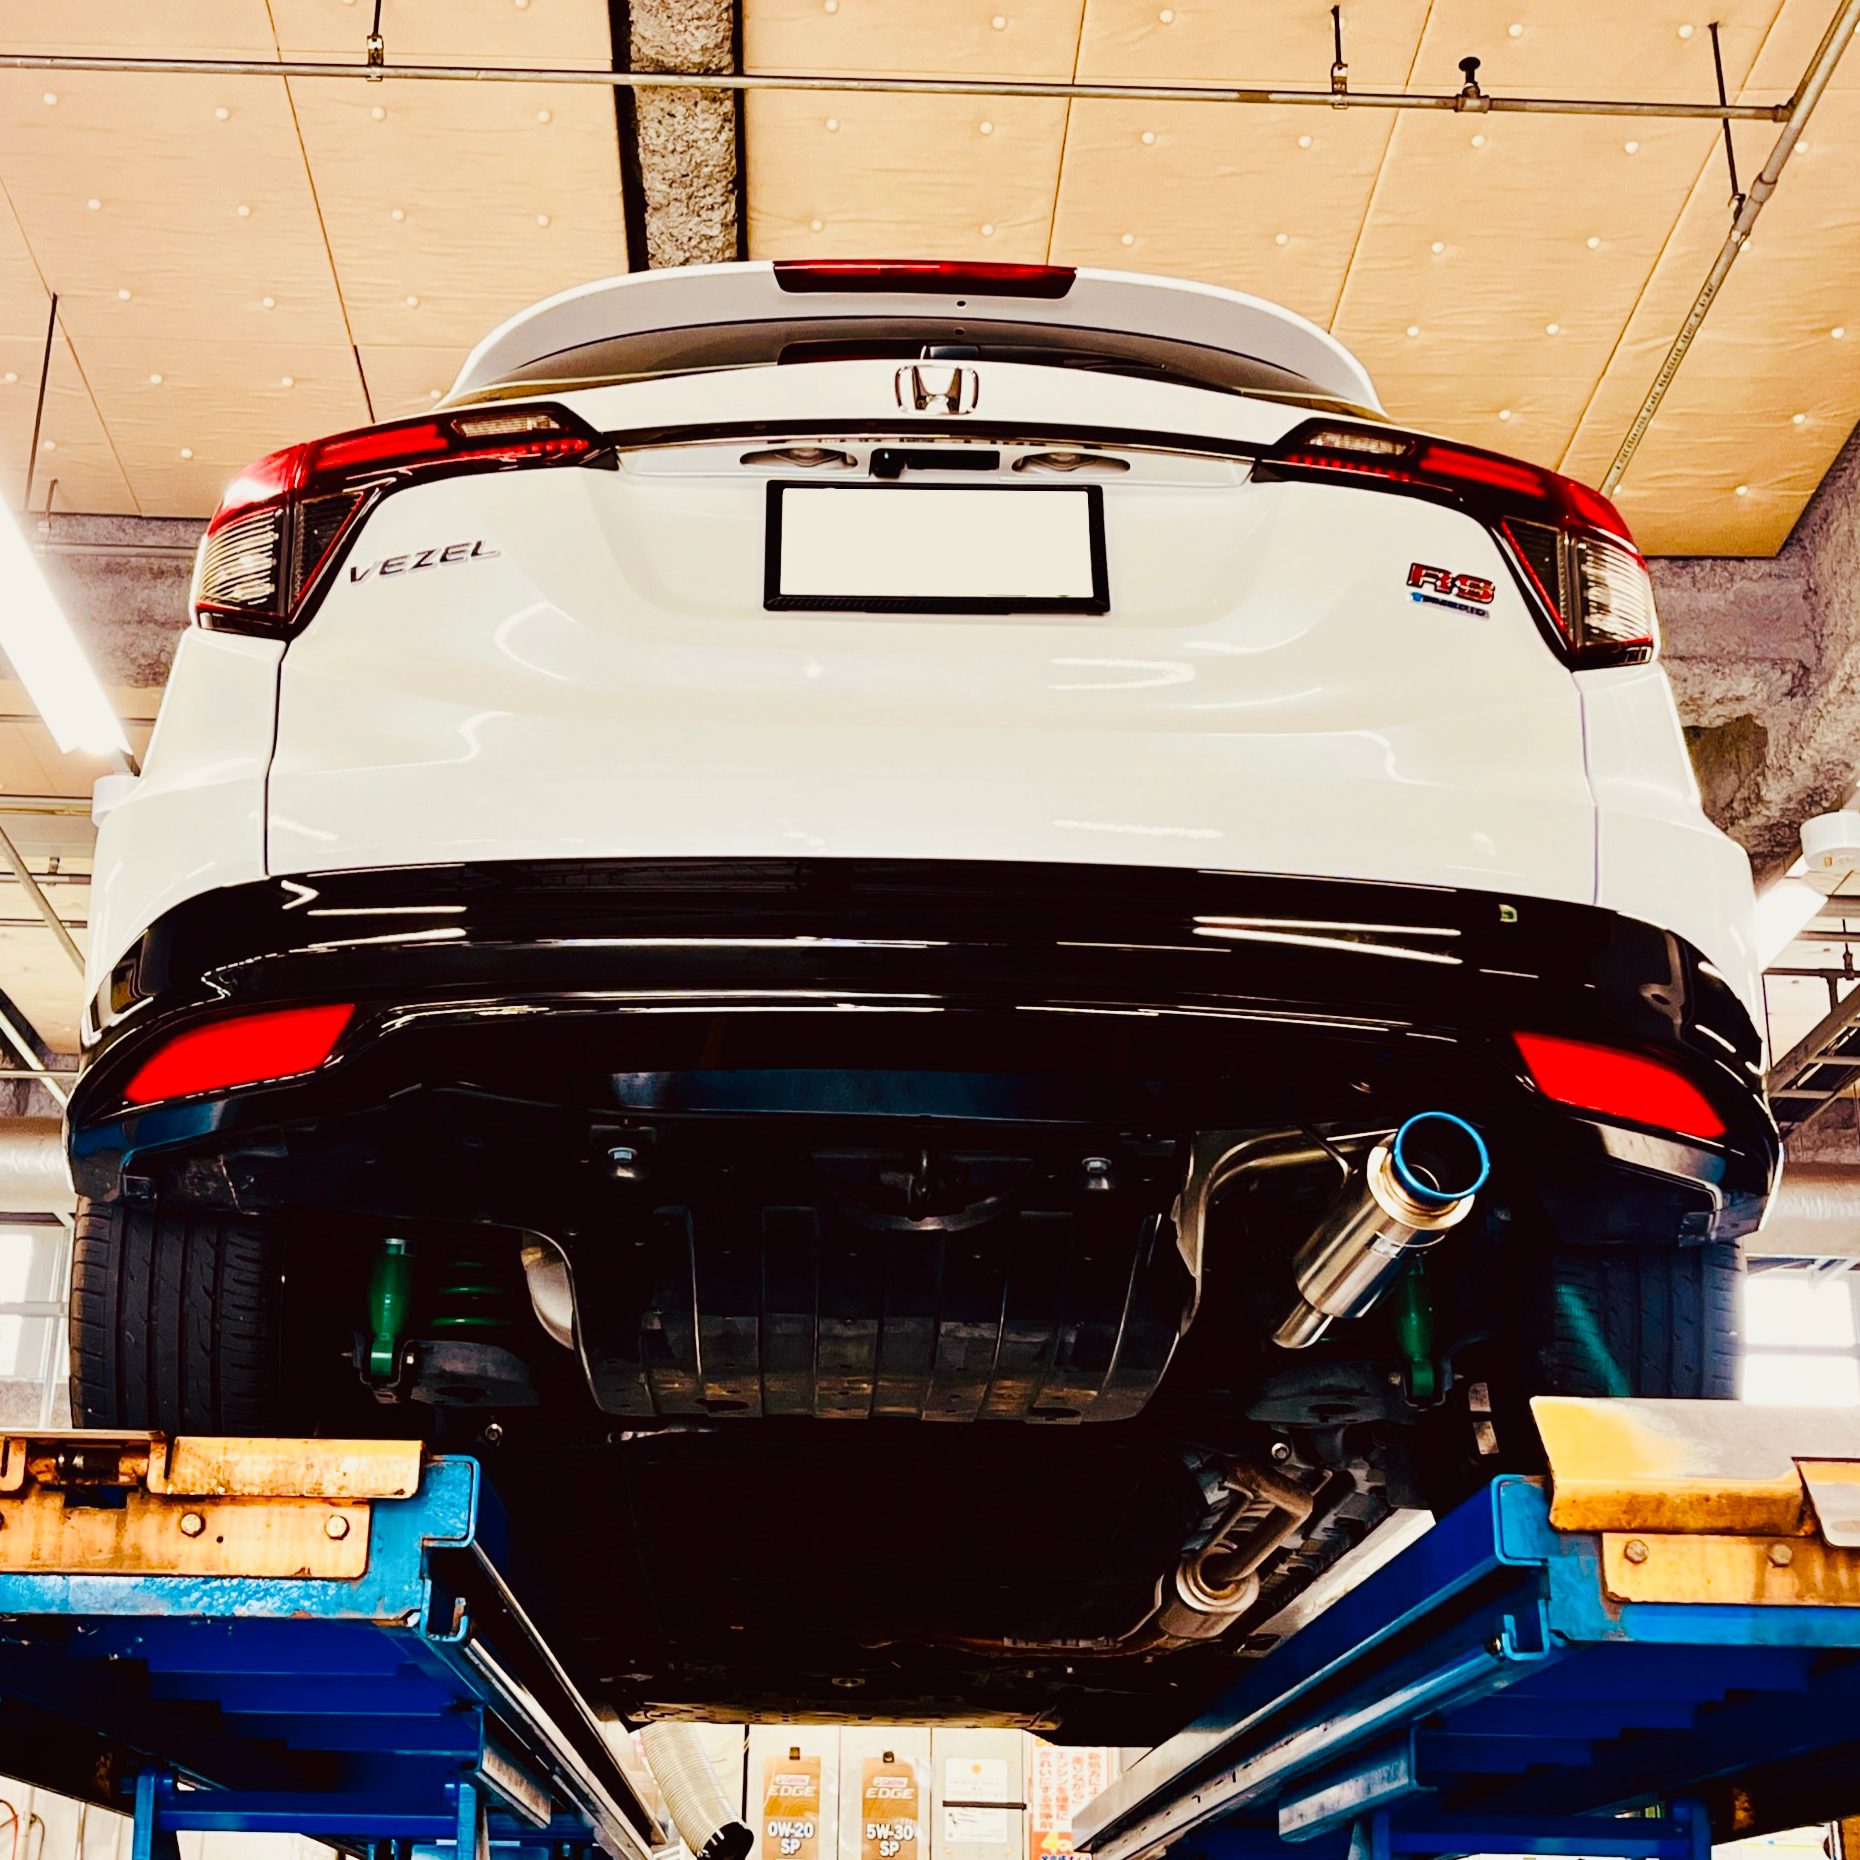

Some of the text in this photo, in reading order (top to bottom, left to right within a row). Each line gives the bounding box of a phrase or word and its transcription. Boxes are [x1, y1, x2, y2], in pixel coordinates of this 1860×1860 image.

[350, 540, 500, 584] VEZEL
[1406, 562, 1496, 605] RS
[769, 1785, 817, 1797] EDGE
[865, 1787, 915, 1799] EDGE
[768, 1821, 815, 1838] 0W-20
[866, 1823, 915, 1841] 5W-30
[780, 1838, 801, 1855] SP
[879, 1840, 900, 1857] SP
